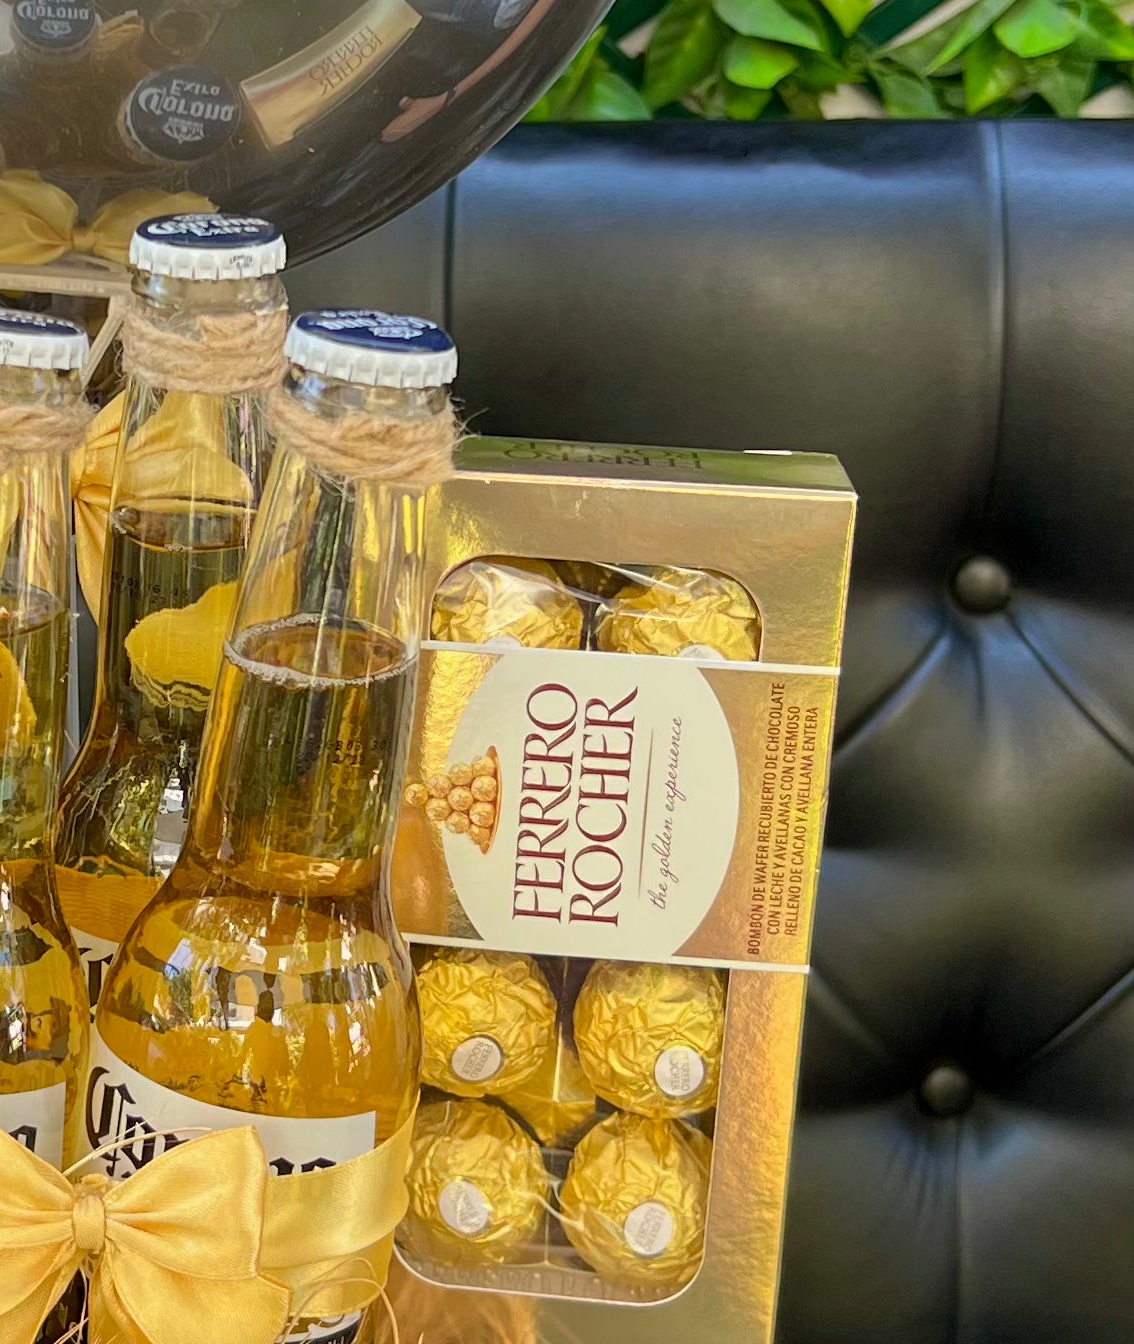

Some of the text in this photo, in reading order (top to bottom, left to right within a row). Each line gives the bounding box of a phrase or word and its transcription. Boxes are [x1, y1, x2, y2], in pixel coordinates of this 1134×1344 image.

[766, 683, 785, 751] CHOCOLATE
[783, 706, 801, 763] CREMOSO
[764, 754, 777, 769] DE
[780, 767, 795, 790] CON
[512, 683, 578, 924] FERRERO
[568, 685, 639, 928] ROCHER
[647, 715, 687, 911] the golden experience
[757, 772, 776, 842] RECUBIERTO
[774, 794, 792, 860] AVELLANAS
[784, 707, 819, 936] RELLENO DE CACAO Y AVELLANA ENTERA
[751, 886, 765, 901] DE
[753, 845, 769, 884] WAFER
[769, 872, 784, 907] LECHE
[767, 911, 780, 935] CON
